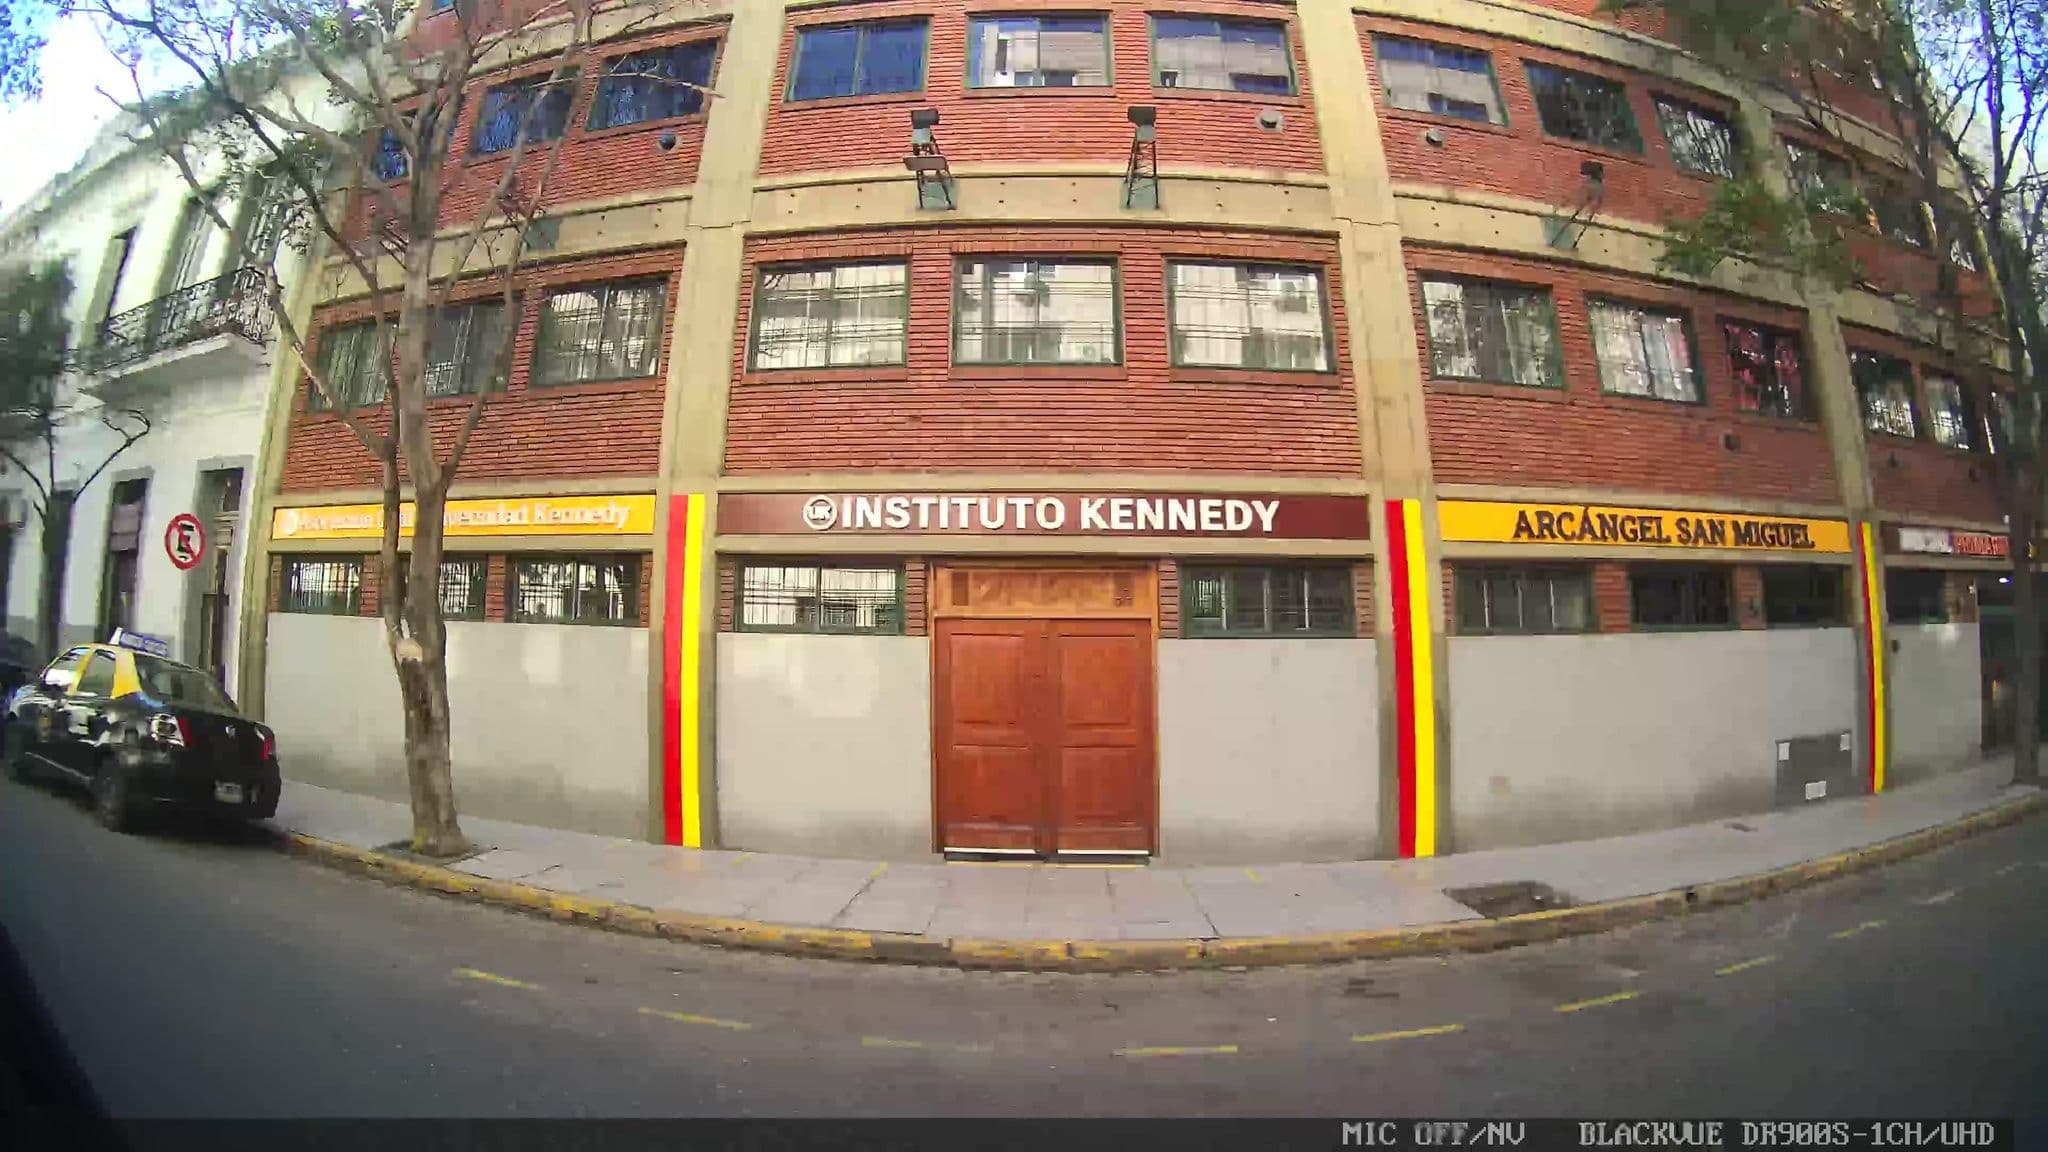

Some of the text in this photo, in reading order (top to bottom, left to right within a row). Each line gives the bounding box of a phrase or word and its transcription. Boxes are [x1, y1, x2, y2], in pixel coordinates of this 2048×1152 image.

[842, 496, 1066, 530] INSTITUTO
[1080, 498, 1279, 532] KENNEDY
[1512, 506, 1816, 549] ARCÁNGEL SAN MIGUEL
